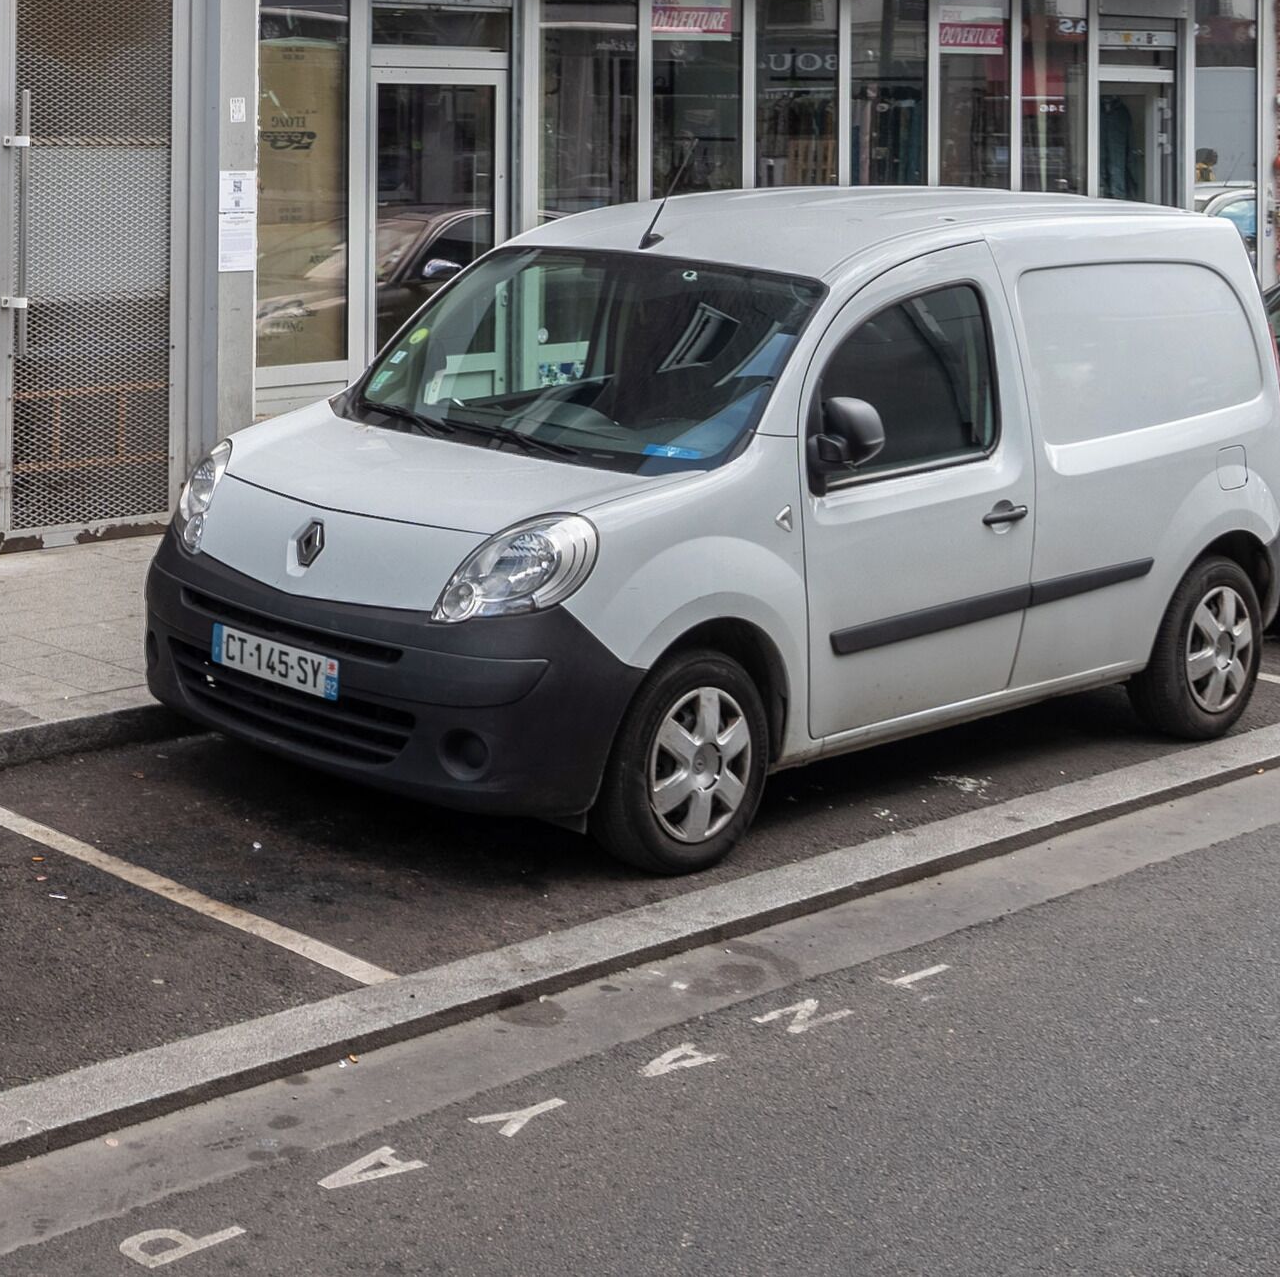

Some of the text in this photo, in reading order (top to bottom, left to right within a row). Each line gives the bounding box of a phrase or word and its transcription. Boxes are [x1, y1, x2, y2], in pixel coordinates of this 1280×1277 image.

[653, 10, 728, 30] OUVERTURE
[940, 26, 1001, 45] OUVERTURE
[225, 633, 322, 689] CT-145-SY
[324, 680, 337, 696] 92
